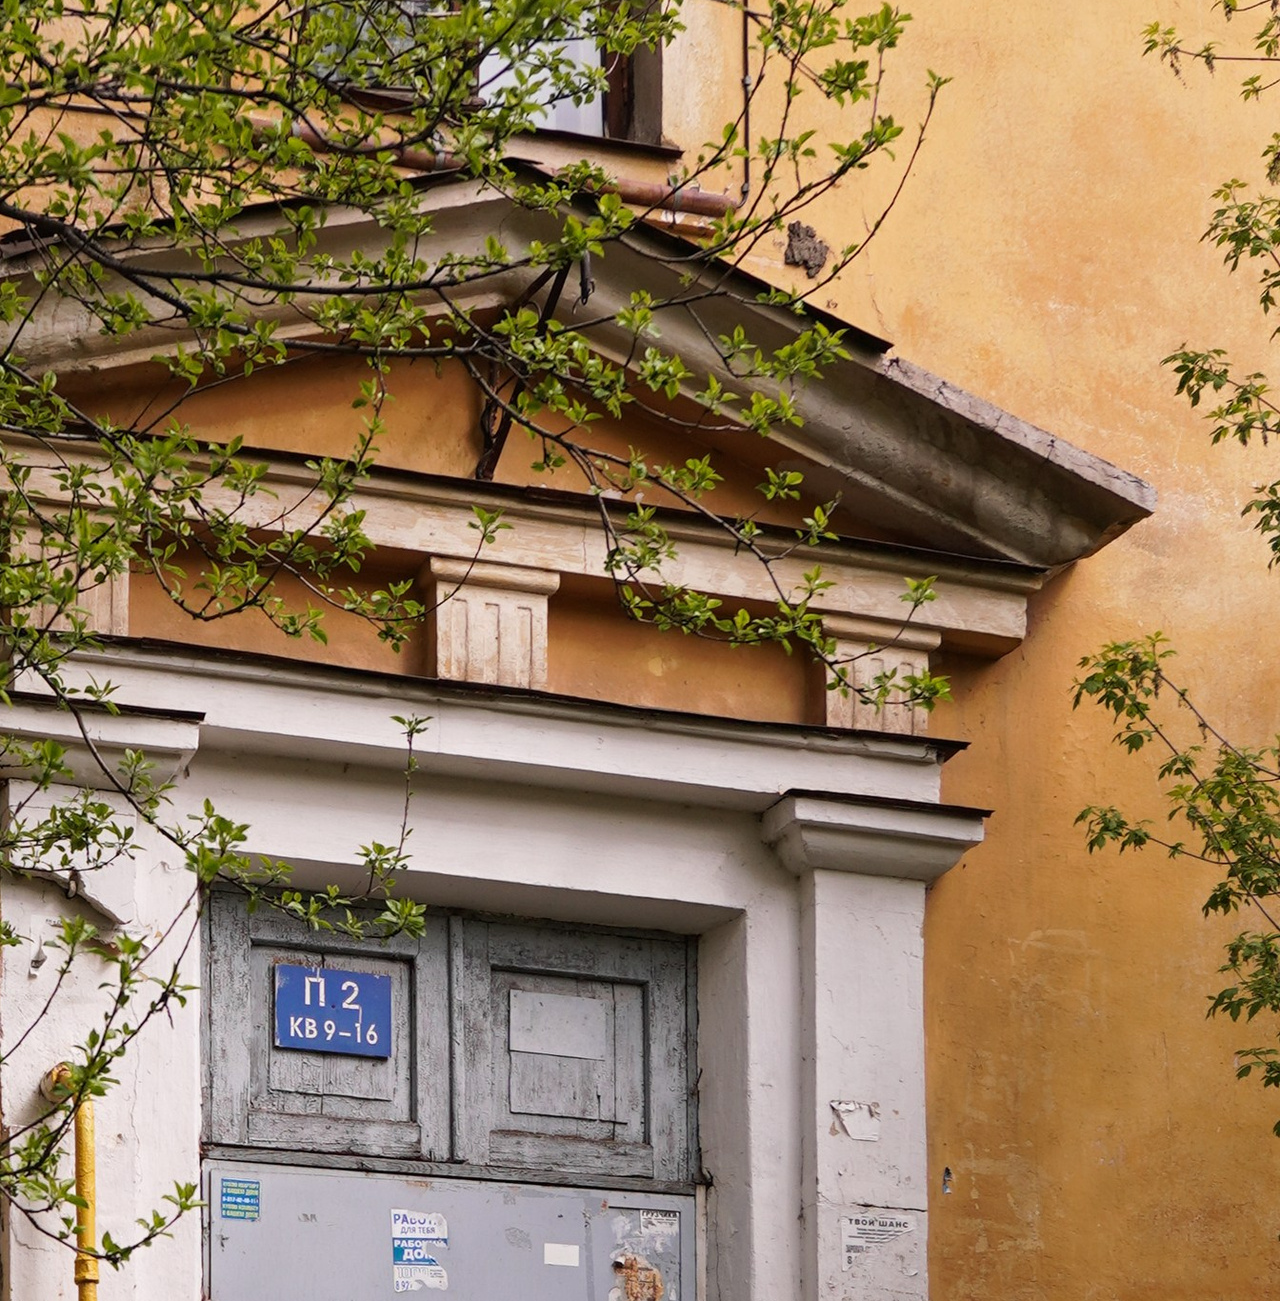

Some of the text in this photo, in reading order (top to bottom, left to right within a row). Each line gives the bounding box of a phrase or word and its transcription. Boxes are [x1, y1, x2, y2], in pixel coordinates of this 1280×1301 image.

[305, 976, 360, 1010] П 2
[878, 1220, 909, 1229] ШАНС
